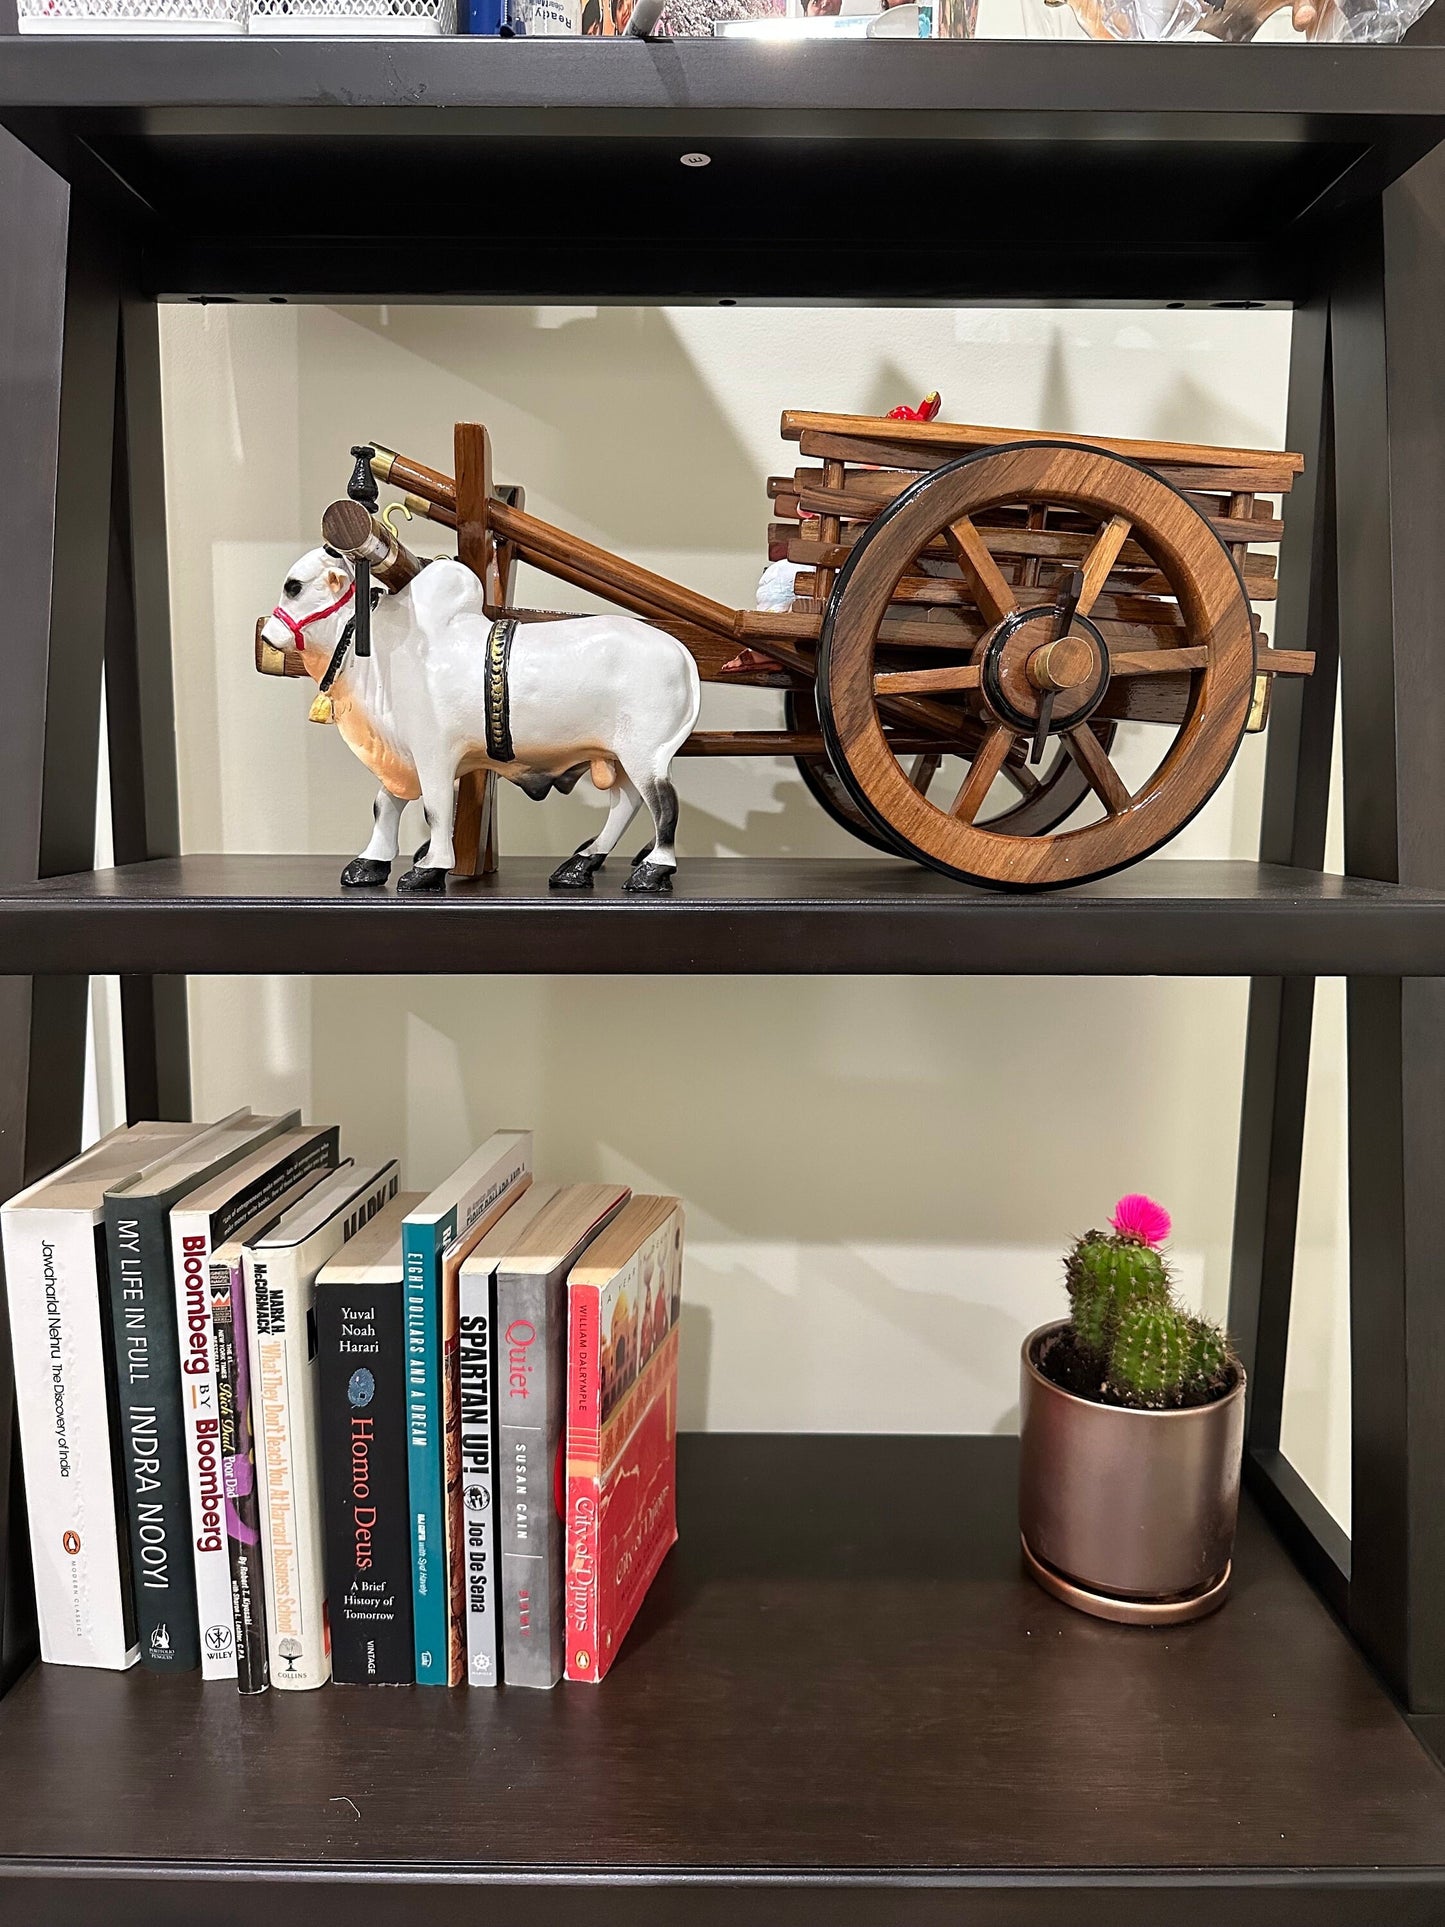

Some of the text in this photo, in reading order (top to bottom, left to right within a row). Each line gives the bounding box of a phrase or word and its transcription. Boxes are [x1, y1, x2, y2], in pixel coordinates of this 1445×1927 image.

[535, 8, 572, 29] Ready
[254, 1264, 270, 1335] McCORMACK
[269, 1290, 286, 1336] MARK H.
[341, 1307, 375, 1320] Yuval
[342, 1324, 376, 1336] Noah
[41, 1240, 69, 1477] Jawaharlal Nehru The Discovery of India
[339, 1341, 379, 1352] Harari
[408, 1253, 427, 1447] EIGHT DOLLARS AND A DREAM
[505, 1319, 537, 1399] Quiet
[578, 1305, 588, 1412] WILLIAM DALRYMPLE
[117, 1219, 169, 1588] MY LIFE IN FULL INDRA NOOYI
[182, 1235, 223, 1552] Bloomberg BY Bloomberg
[219, 1383, 233, 1415] Rich
[262, 1376, 283, 1401] They
[460, 1316, 490, 1474] SPARTAN UP!
[265, 1404, 285, 1433] Don't
[266, 1434, 287, 1466] Teach
[224, 1456, 236, 1478] Poor
[269, 1467, 288, 1486] You
[227, 1479, 238, 1498] Dad
[270, 1488, 289, 1501] At
[351, 1417, 376, 1568] Homo Deus
[515, 1443, 528, 1539] SUSAN CAIN
[271, 1502, 291, 1546] Harvard
[468, 1520, 486, 1547] Joe
[274, 1548, 293, 1596] Business
[569, 1497, 595, 1632] City of Djinns
[344, 1595, 395, 1608] History of
[351, 1581, 387, 1592] A Brief
[470, 1575, 488, 1613] Sena
[343, 1609, 395, 1620] Tomorrow
[206, 1650, 233, 1660] WILEY
[367, 1640, 376, 1675] VINTAGE
